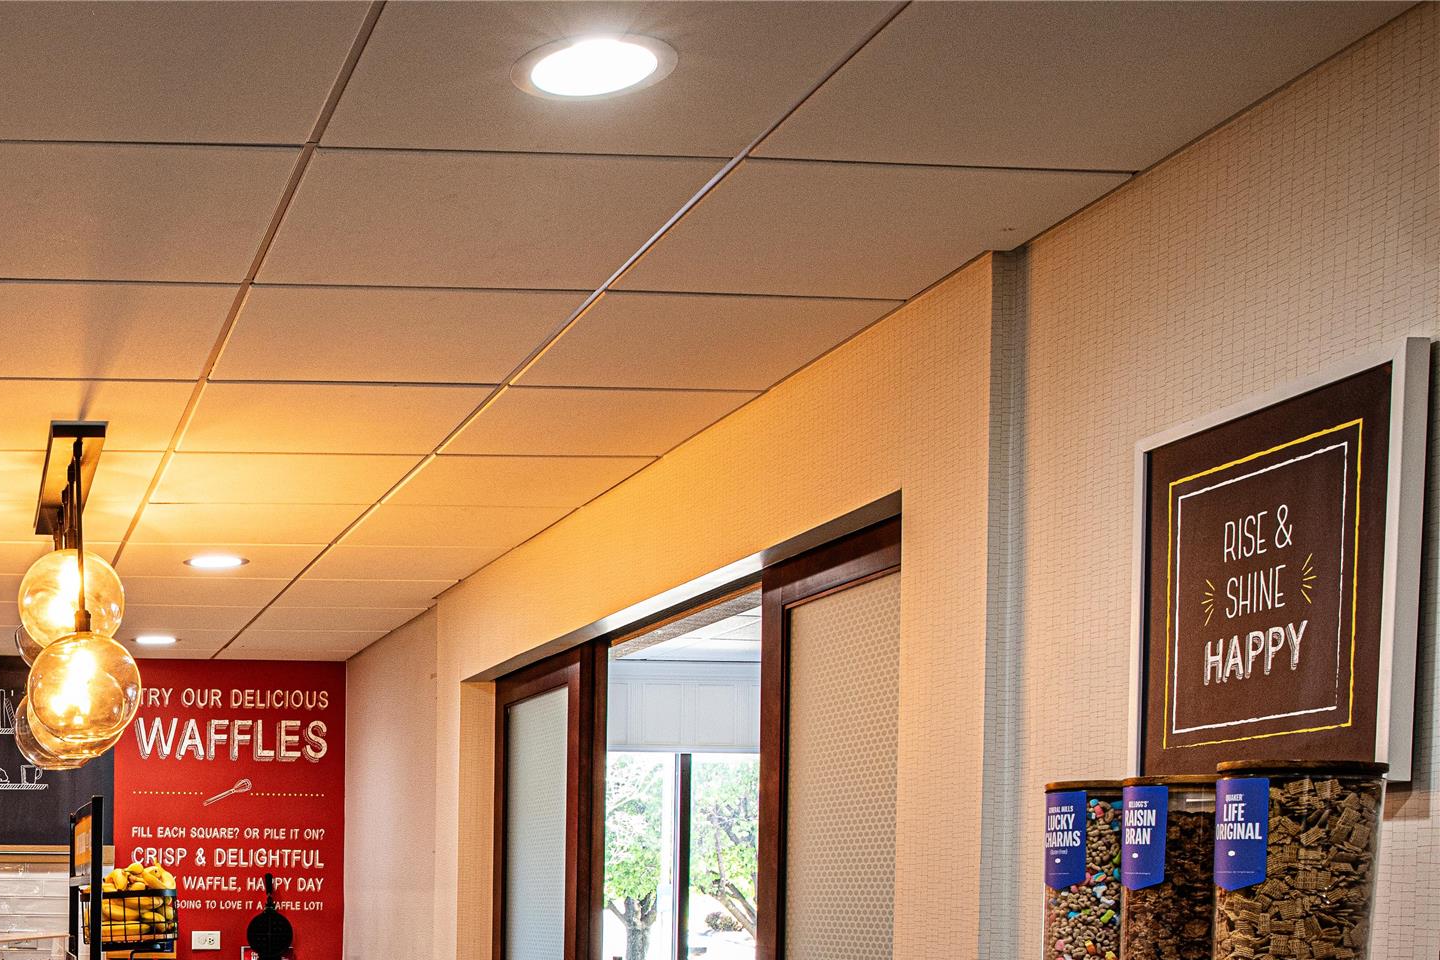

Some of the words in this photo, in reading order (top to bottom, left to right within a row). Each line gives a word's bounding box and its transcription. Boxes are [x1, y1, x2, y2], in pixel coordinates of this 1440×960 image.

[1224, 511, 1268, 562] RISE
[1275, 504, 1293, 549] &
[1225, 564, 1286, 619] SHINE
[1203, 620, 1309, 686] HAPPY
[140, 687, 173, 709] TRY
[181, 687, 223, 709] OUR
[229, 688, 329, 711] DELICIOUS
[134, 716, 329, 763] WAFFLES
[1225, 794, 1244, 802] QUAKER
[1124, 809, 1156, 827] RAISIN
[1223, 803, 1245, 822] LIFE
[1047, 813, 1076, 832] LUCKY
[1215, 822, 1263, 841] ORIGINAL
[131, 826, 153, 839] FILL
[156, 827, 186, 839] EACH
[190, 827, 240, 840] SQUARE?
[244, 828, 259, 840] OR
[263, 828, 287, 840] PILE
[289, 828, 300, 840] IT
[304, 828, 326, 841] ON?
[1045, 830, 1082, 849] CHARMS
[1125, 828, 1152, 845] BRAN
[131, 846, 187, 867] CRISP
[194, 847, 207, 867] &
[213, 848, 325, 868] DELIGHTFUL
[183, 875, 242, 893] WAFFLE,
[246, 877, 292, 892] HAPY
[296, 878, 324, 892] DAY
[175, 899, 202, 910] GOING
[205, 899, 217, 910] TO
[219, 900, 243, 911] LOVE
[245, 900, 253, 910] IT
[256, 901, 263, 911] A
[272, 901, 301, 911] AFFLE
[303, 901, 324, 912] LOT!
